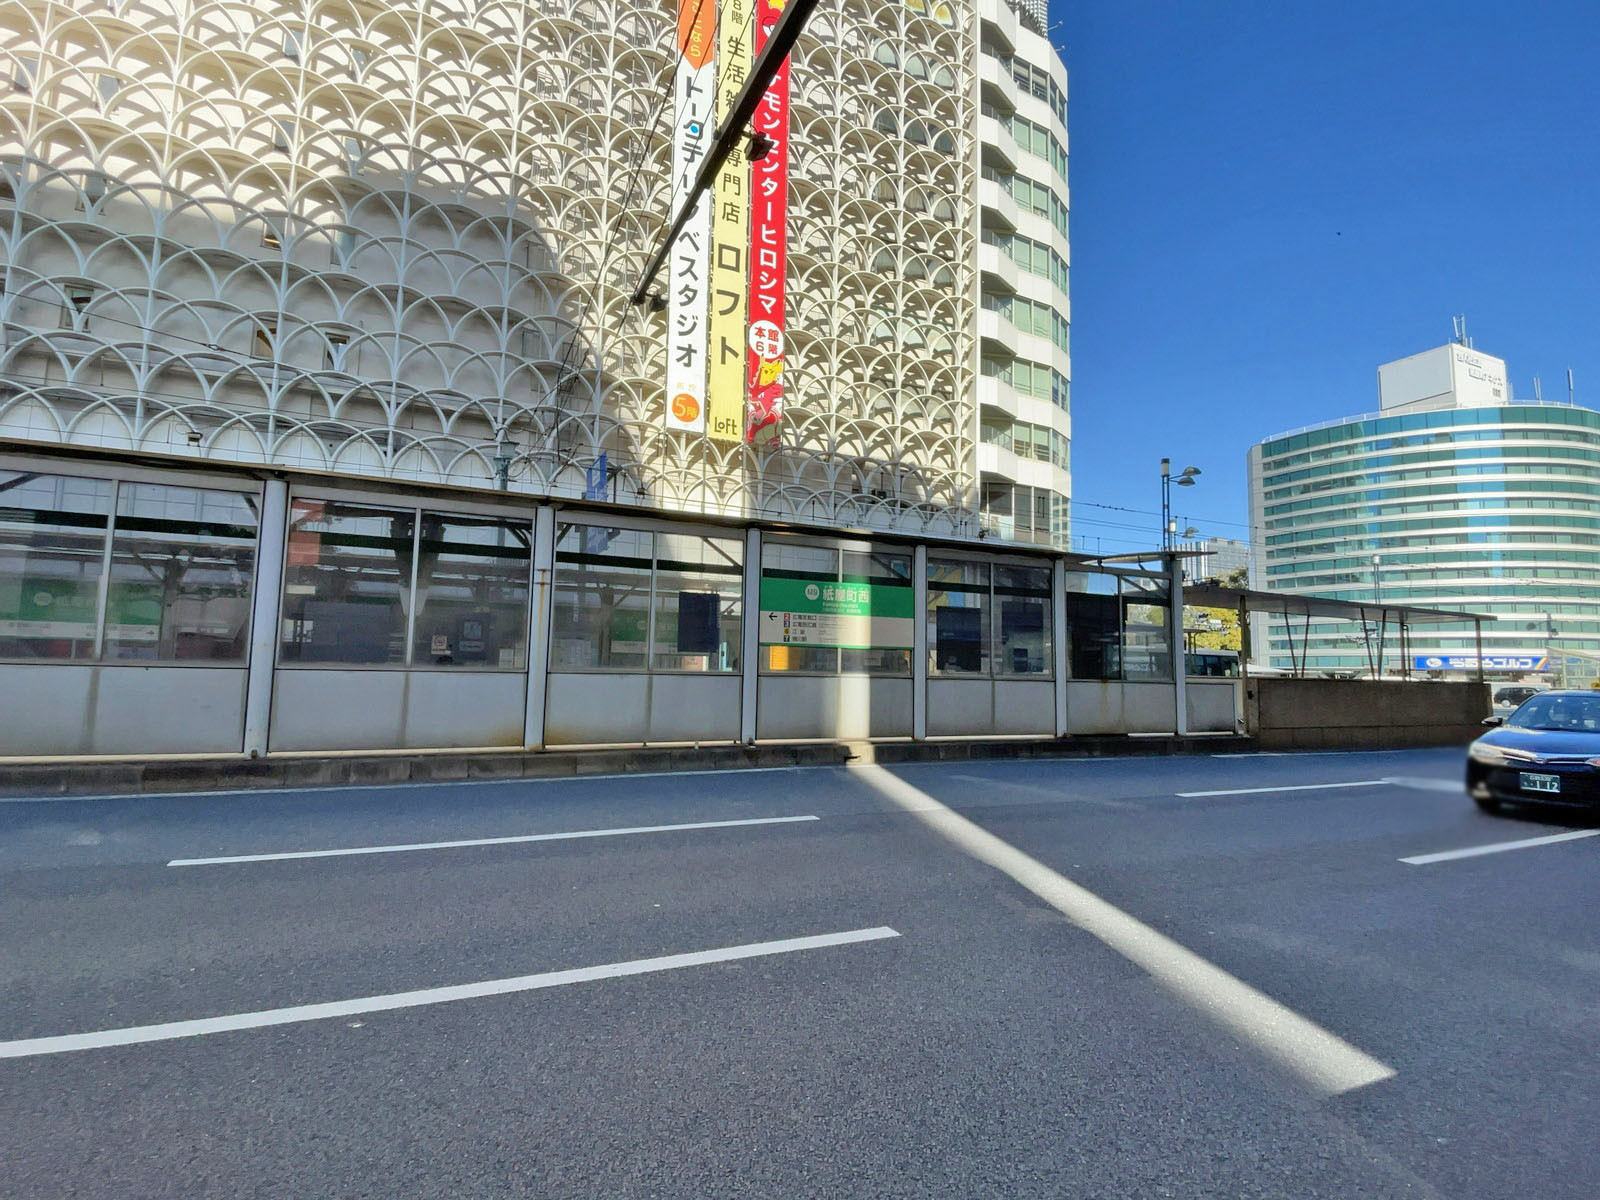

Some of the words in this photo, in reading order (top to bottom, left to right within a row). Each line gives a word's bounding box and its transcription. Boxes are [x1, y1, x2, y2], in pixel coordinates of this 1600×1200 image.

[722, 36, 745, 224] 生活専門店
[758, 74, 782, 314] モンセンターヒロシマ
[716, 243, 741, 365] ロフト
[754, 326, 779, 343] 本館
